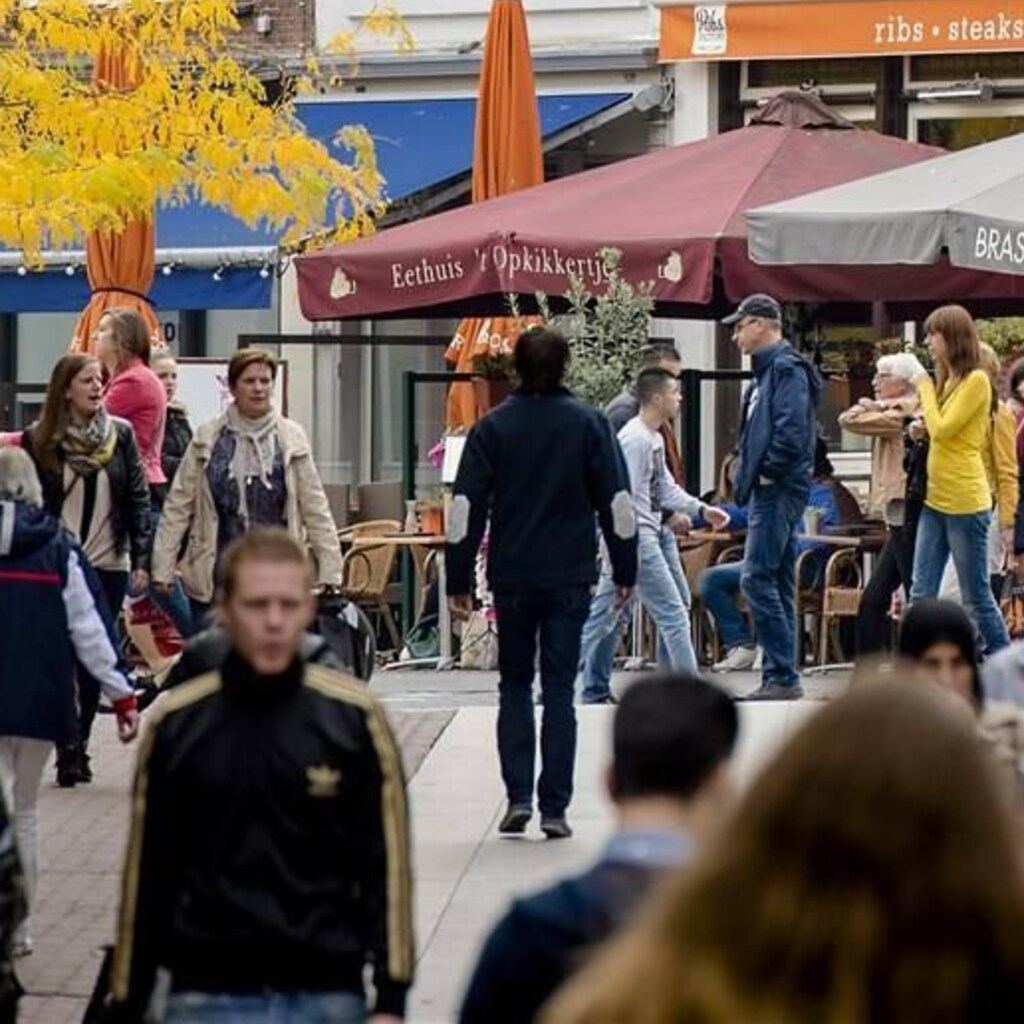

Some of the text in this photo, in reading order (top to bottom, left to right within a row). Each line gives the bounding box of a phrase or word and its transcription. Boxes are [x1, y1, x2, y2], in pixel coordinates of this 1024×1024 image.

[874, 15, 924, 43] ribs
[948, 13, 1024, 41] steaks
[392, 252, 464, 288] Eethuis
